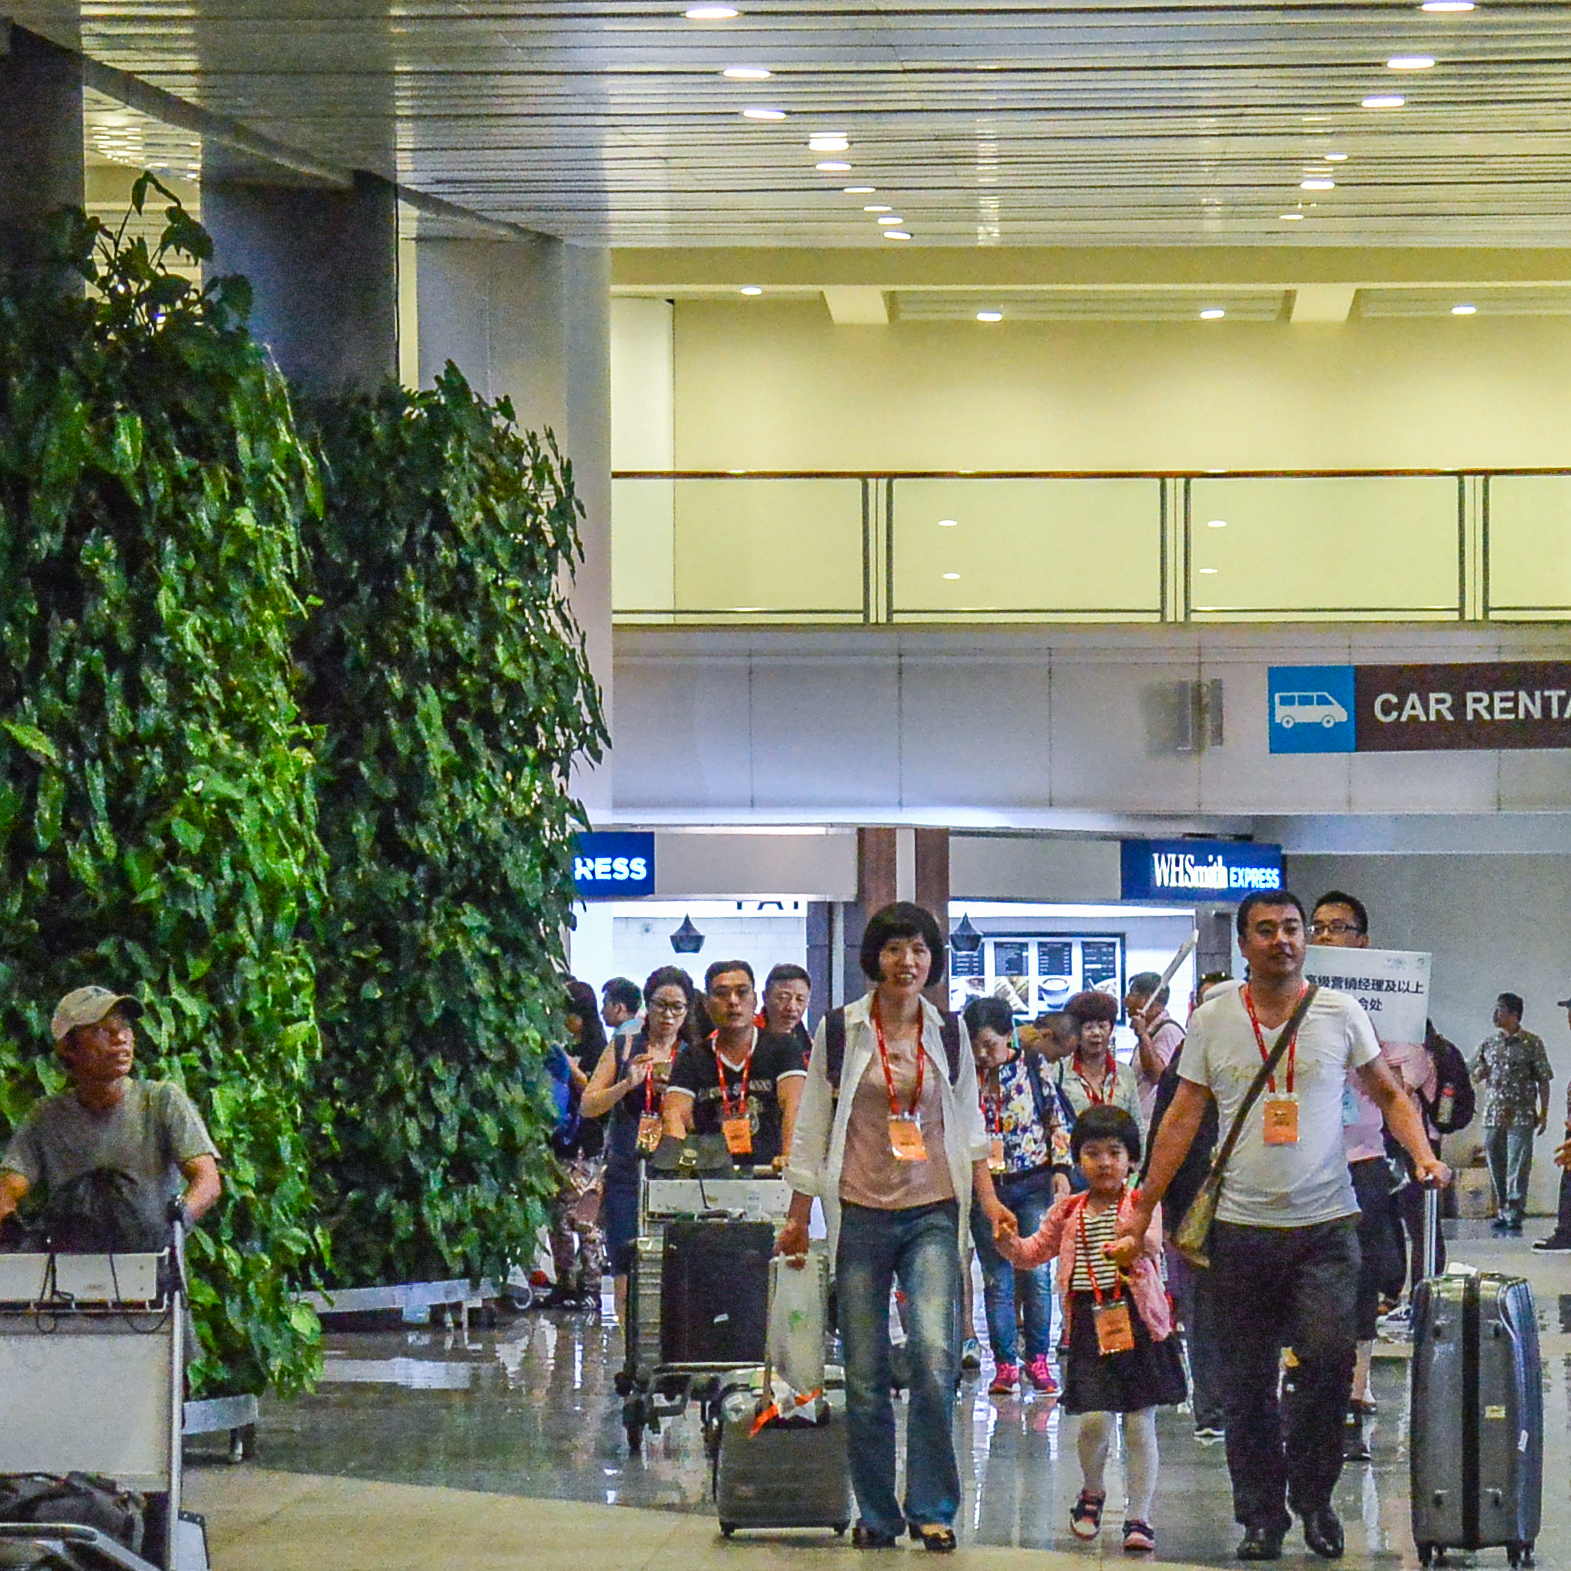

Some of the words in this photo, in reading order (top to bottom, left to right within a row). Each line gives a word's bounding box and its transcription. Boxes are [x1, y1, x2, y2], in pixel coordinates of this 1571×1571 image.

[1374, 692, 1454, 723] CAR
[1152, 852, 1229, 889] WHSmith
[1229, 866, 1280, 889] EXPRESS
